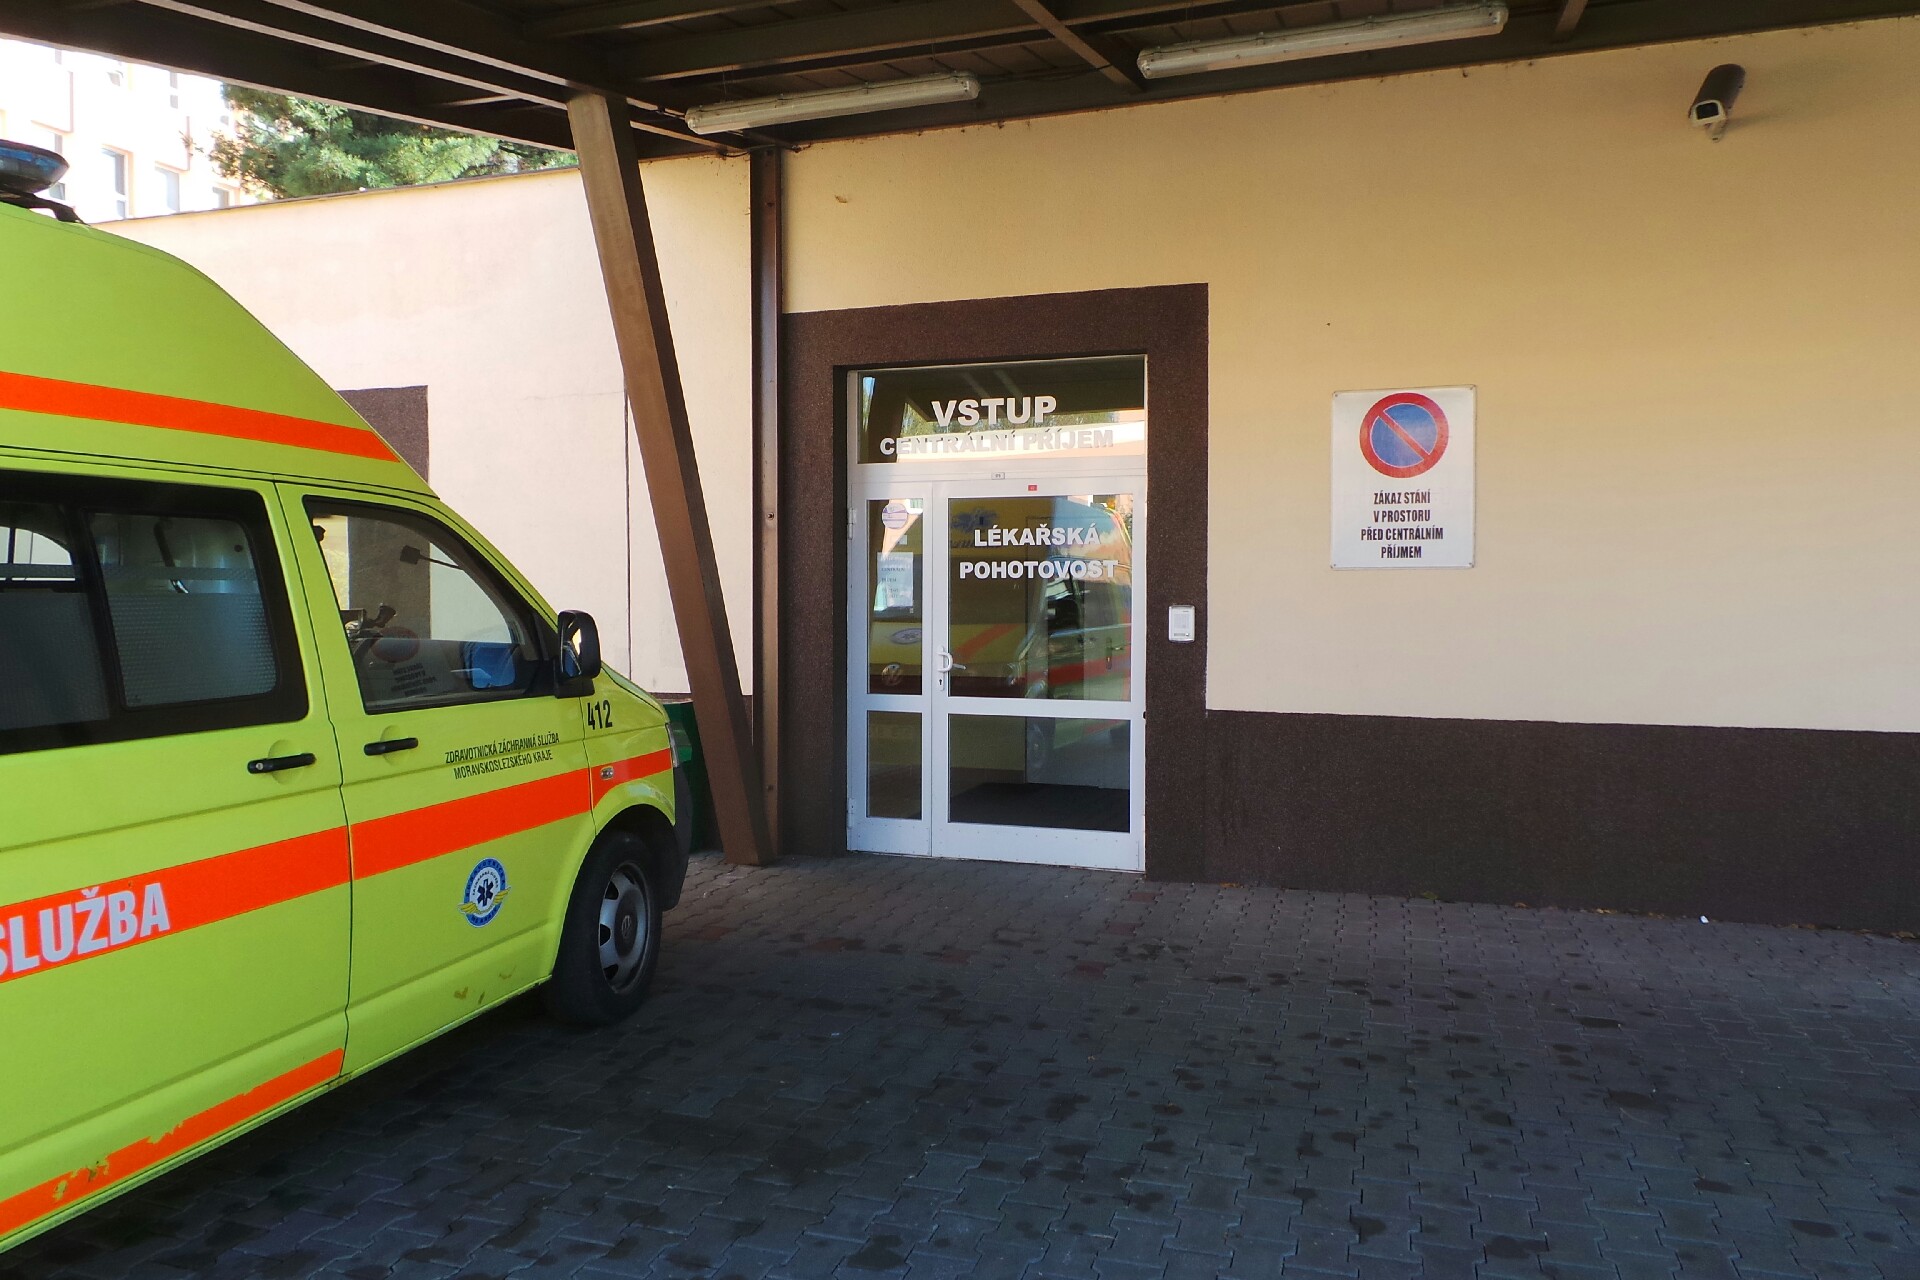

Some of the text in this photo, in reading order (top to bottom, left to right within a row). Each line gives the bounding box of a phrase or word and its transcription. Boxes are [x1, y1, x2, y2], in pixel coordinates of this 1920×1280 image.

[931, 396, 1057, 427] VSTUP
[879, 430, 1016, 455] CENTRÁLNÍ
[1374, 489, 1431, 504] ZÁKAZ STÁNÍ
[1373, 509, 1431, 523] V PROSTORU
[974, 523, 1100, 547] LÉKAŘSKÁ
[1360, 525, 1444, 541] PŘED CENTRÁLNÍM
[1380, 544, 1422, 559] PŘÍJMEM
[959, 560, 1118, 579] POHOTOVOST
[587, 700, 613, 730] 412
[445, 731, 560, 764] ZDRAVOTNICKÁ ZÁCHRANNÁ SLUŽBA
[454, 749, 553, 780] MORAVSKOSLEZSKÉHO KRAJE
[0, 882, 170, 976] LUŽBA
